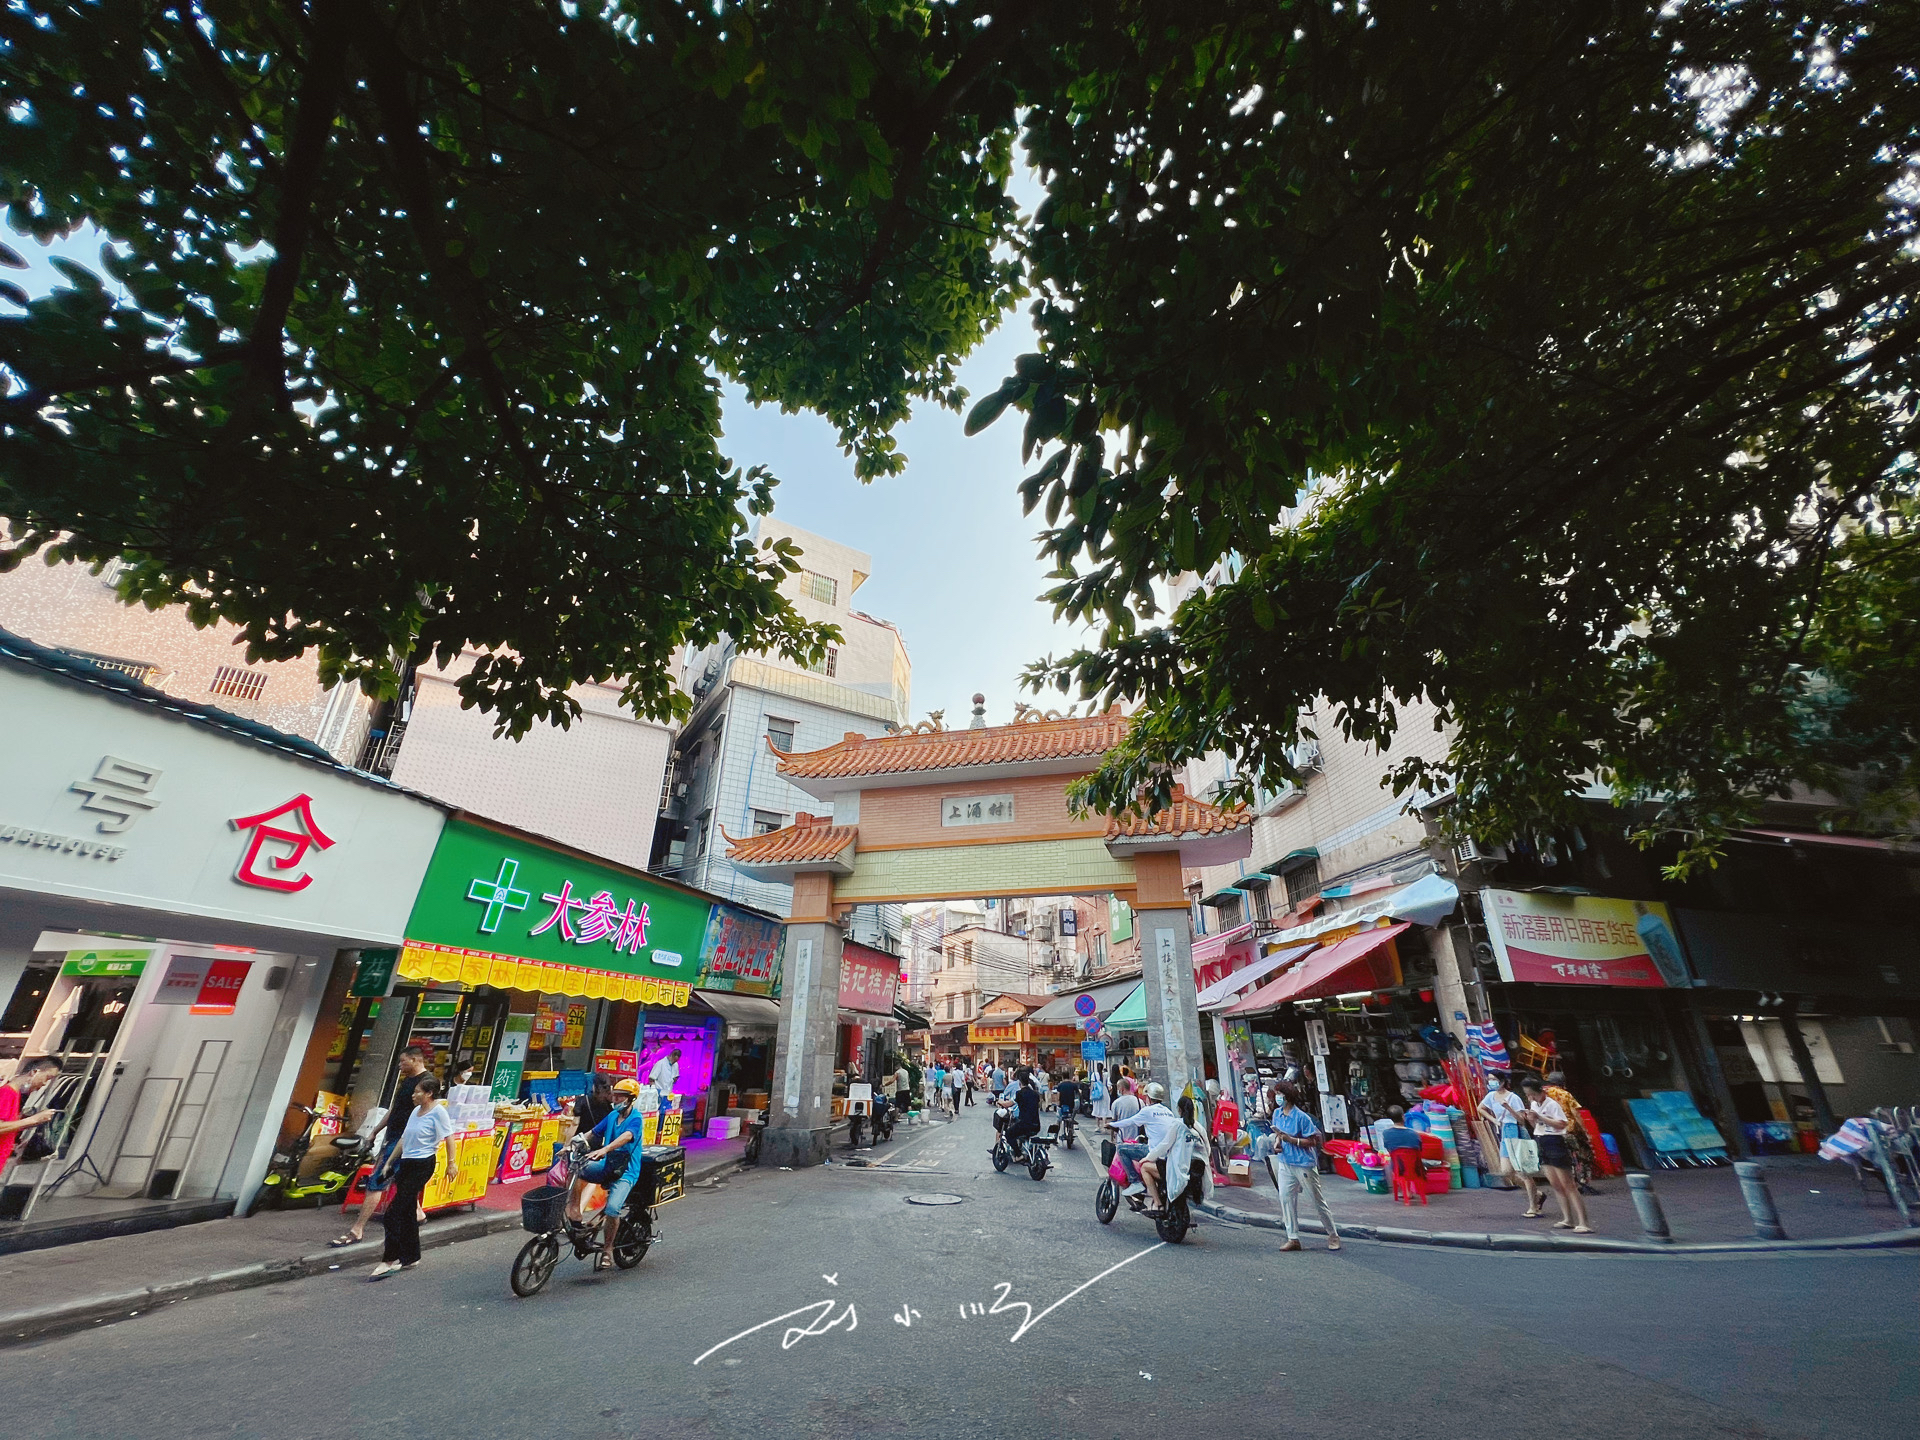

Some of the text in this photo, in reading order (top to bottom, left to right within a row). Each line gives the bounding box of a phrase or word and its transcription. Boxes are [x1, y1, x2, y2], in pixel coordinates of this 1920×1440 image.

[531, 880, 651, 954] 大参林
[205, 975, 243, 990] SALE
